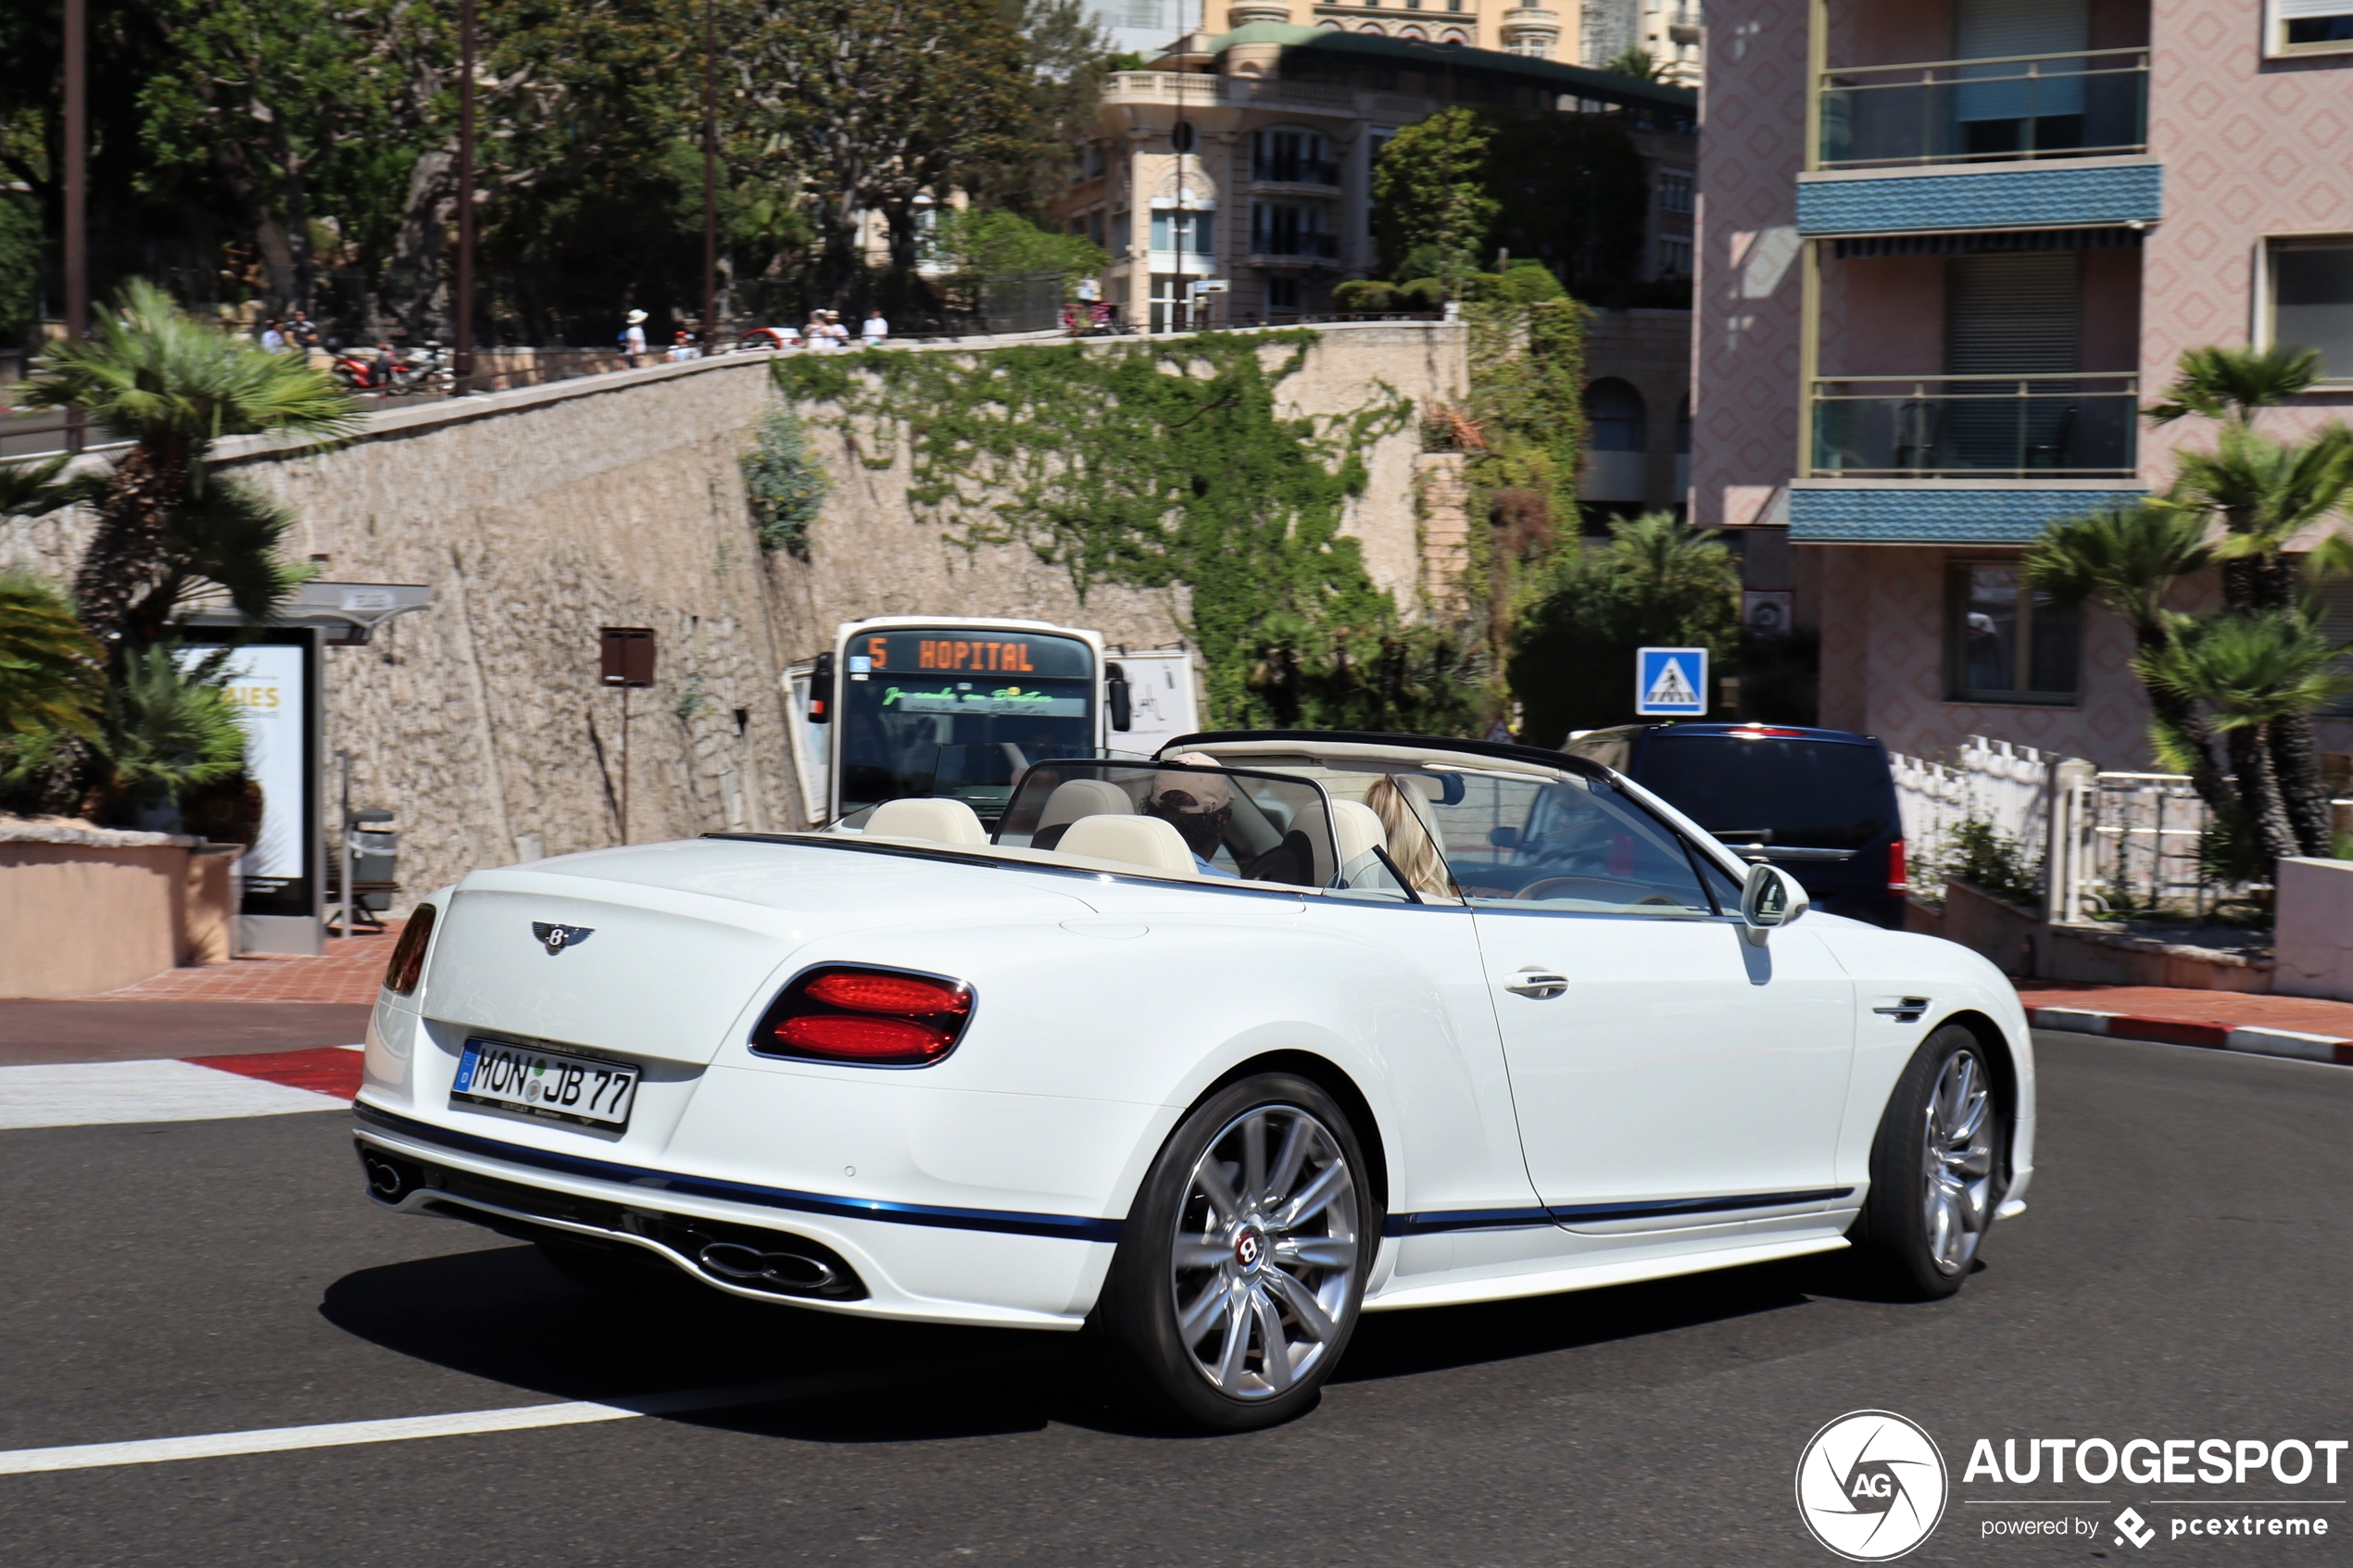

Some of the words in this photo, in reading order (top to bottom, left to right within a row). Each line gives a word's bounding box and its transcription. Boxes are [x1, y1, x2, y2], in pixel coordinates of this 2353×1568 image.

[868, 638, 888, 668] 5
[919, 640, 1034, 671] HOPITAL
[472, 1047, 532, 1097] MON
[543, 1062, 585, 1107] JB
[589, 1070, 632, 1115] 77
